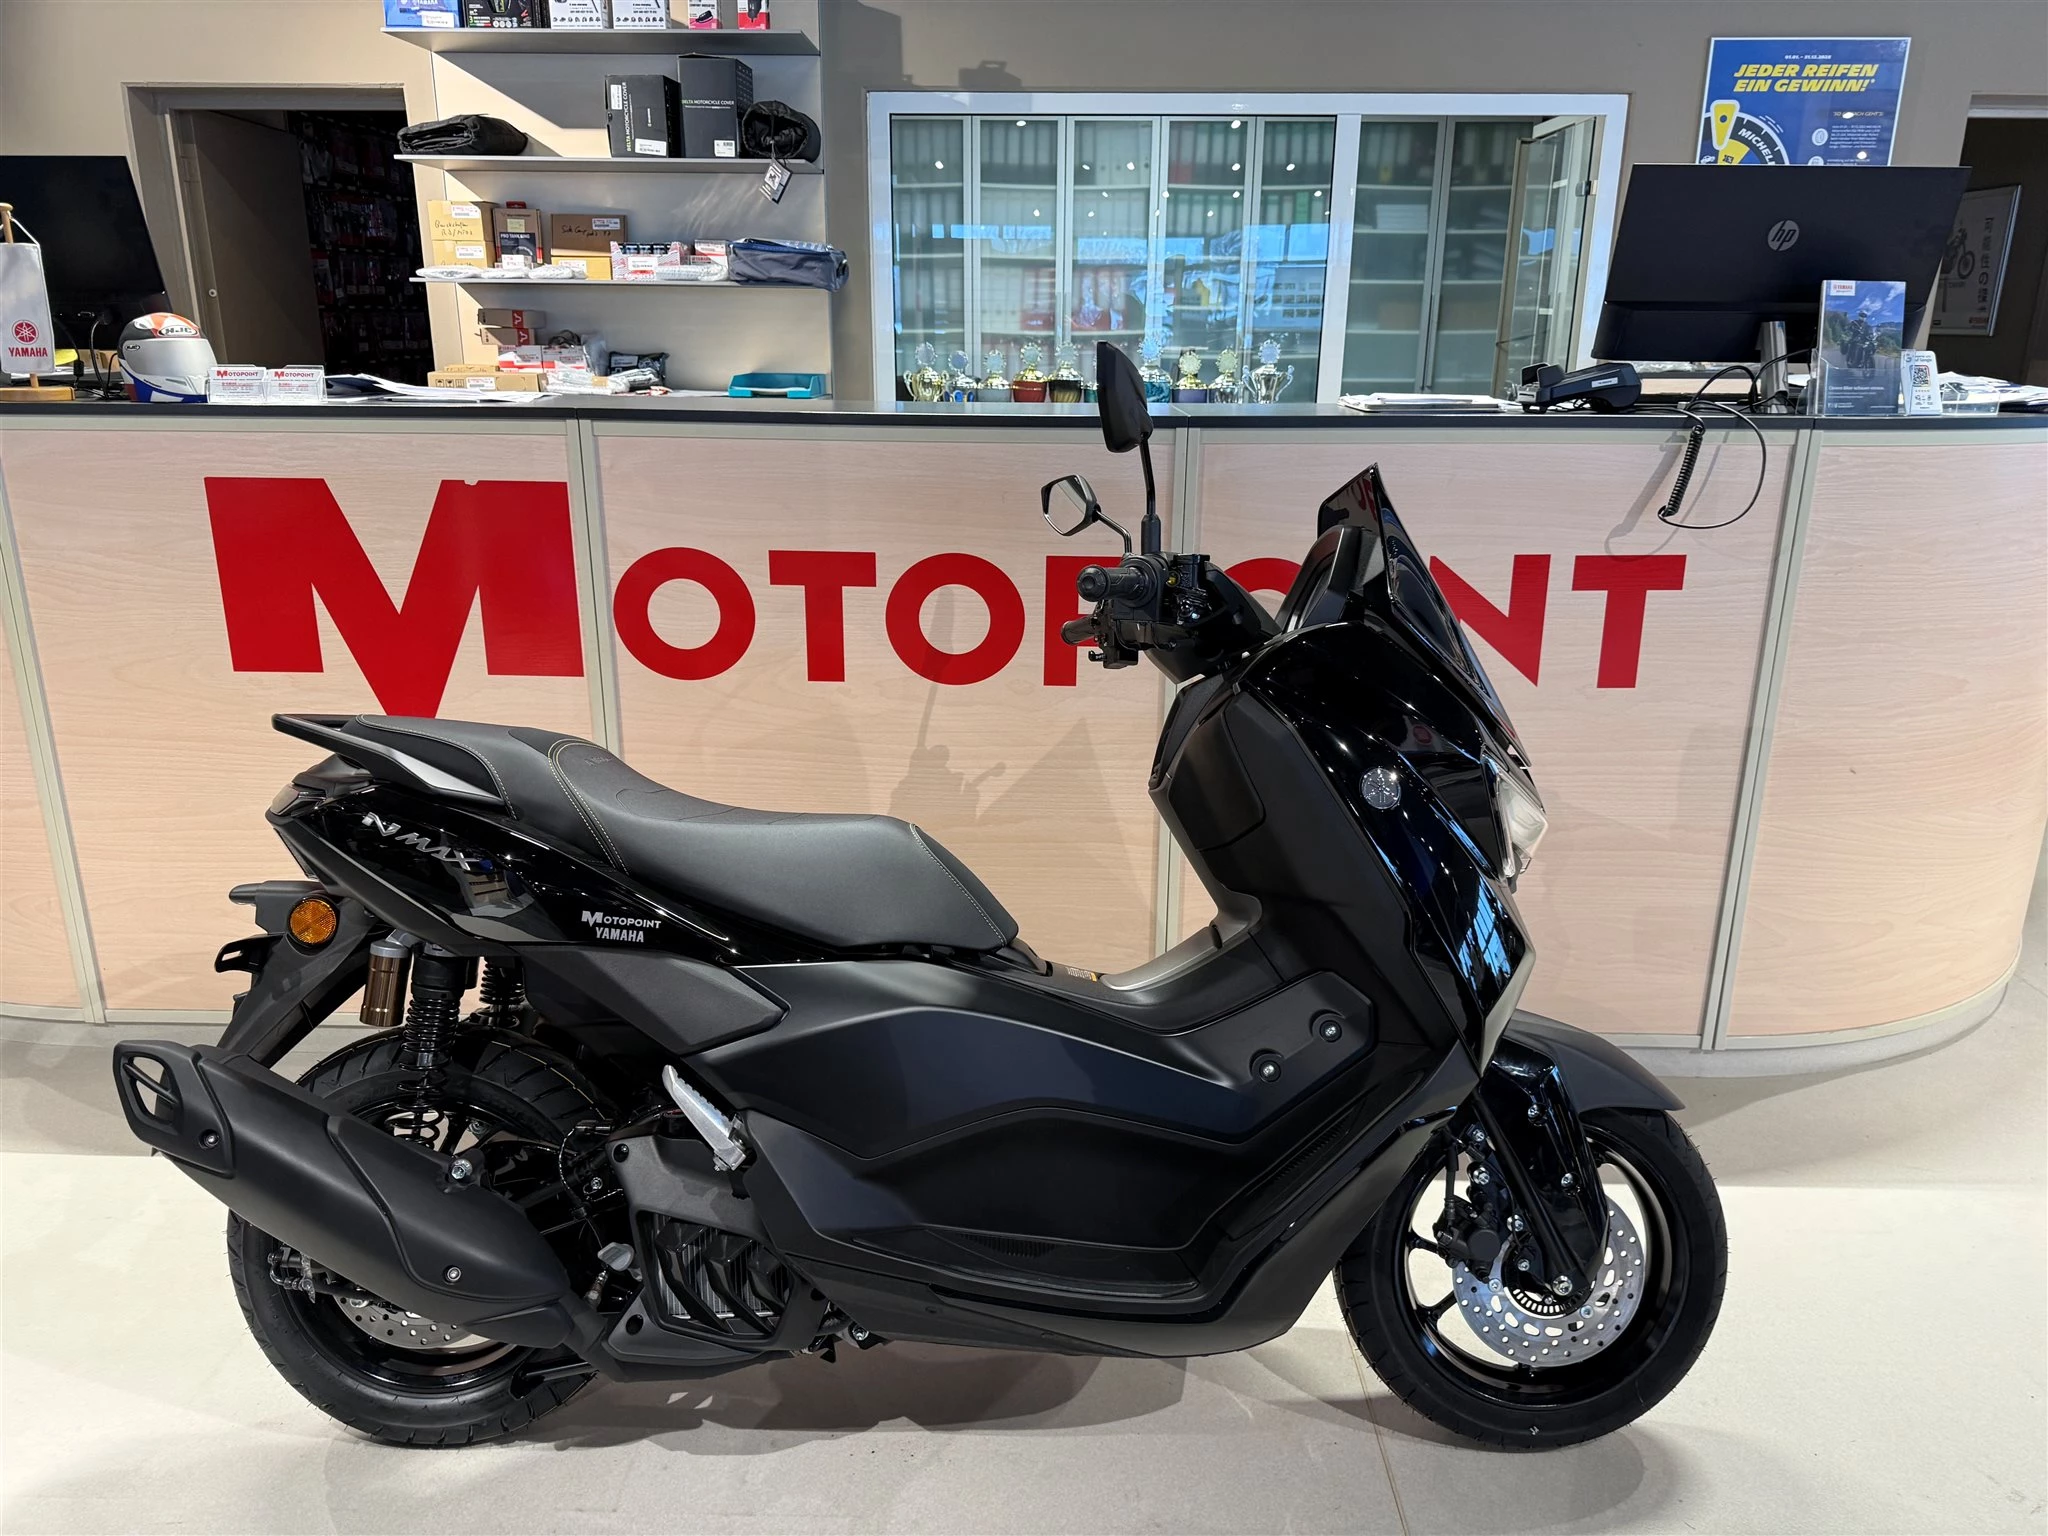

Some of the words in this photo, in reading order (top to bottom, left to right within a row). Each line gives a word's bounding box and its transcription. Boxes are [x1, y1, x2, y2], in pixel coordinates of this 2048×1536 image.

[1733, 64, 1798, 77] JEDER
[1801, 64, 1879, 77] REIFEN
[1733, 79, 1770, 92] EIN
[623, 101, 631, 134] MOTORCYCLE
[1772, 226, 1796, 250] hp
[165, 327, 193, 335] HJC
[8, 346, 48, 358] YAMAHA
[216, 370, 259, 378] MOTOPOINT
[274, 371, 315, 379] MOTOPOINT
[581, 910, 662, 929] MOTOPOINT
[595, 927, 645, 943] YAMAHA
